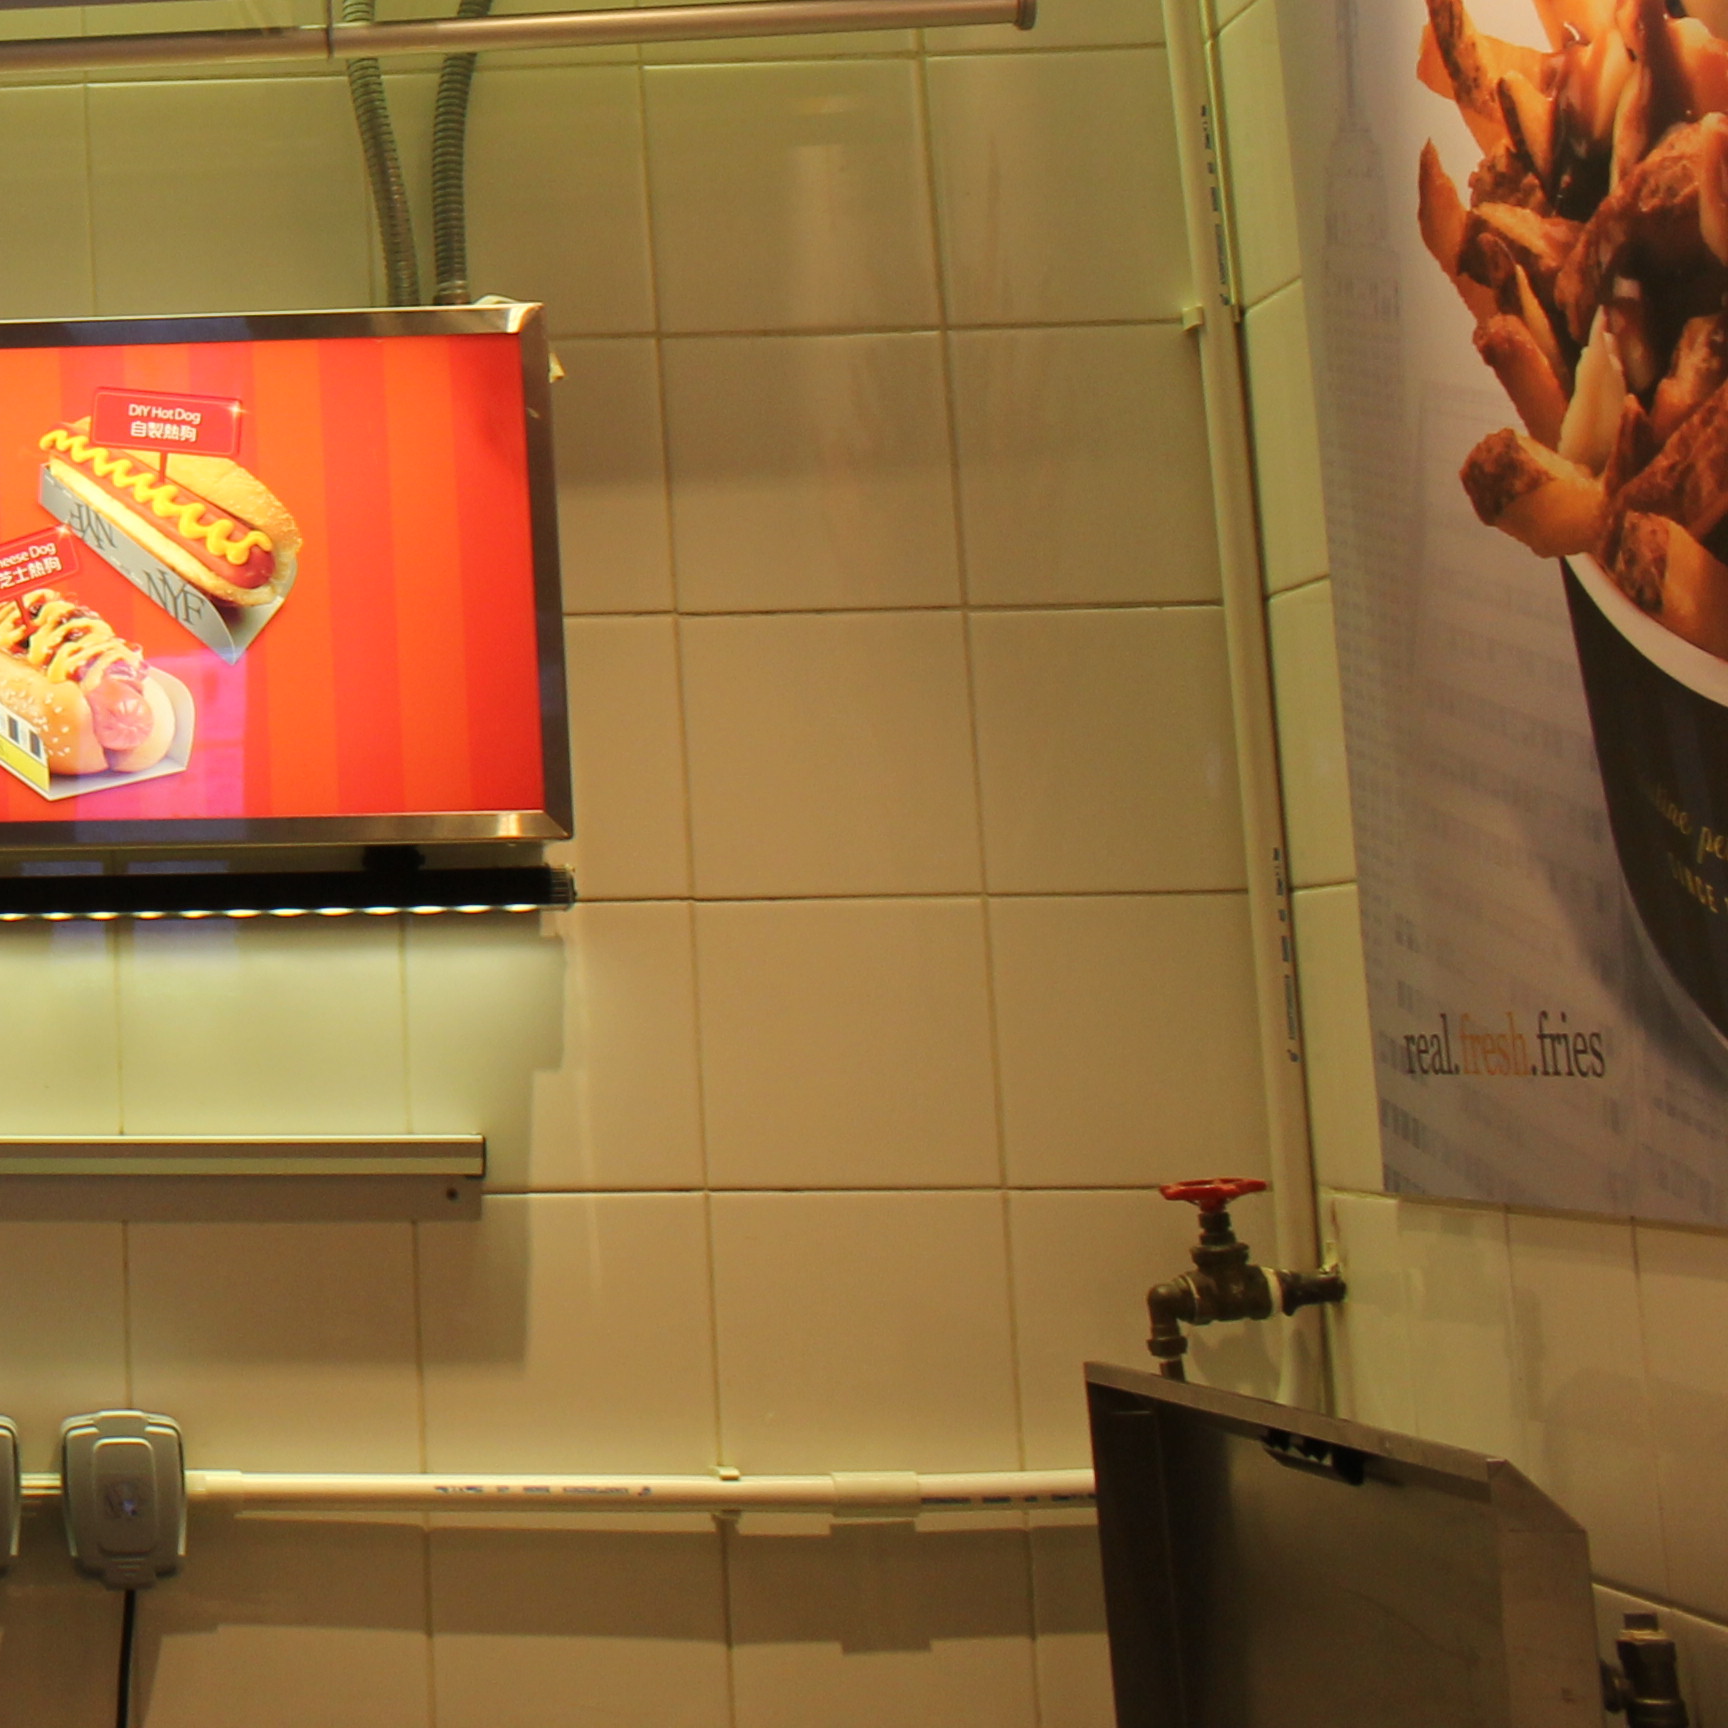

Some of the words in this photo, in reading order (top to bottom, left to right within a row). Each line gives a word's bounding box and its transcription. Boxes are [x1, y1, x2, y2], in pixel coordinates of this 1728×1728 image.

[128, 404, 151, 416] DIY
[151, 407, 174, 420] Hot
[175, 408, 201, 424] Dog
[131, 420, 197, 442] 自製熱狗
[28, 543, 56, 559] Dog
[143, 569, 205, 625] NYF
